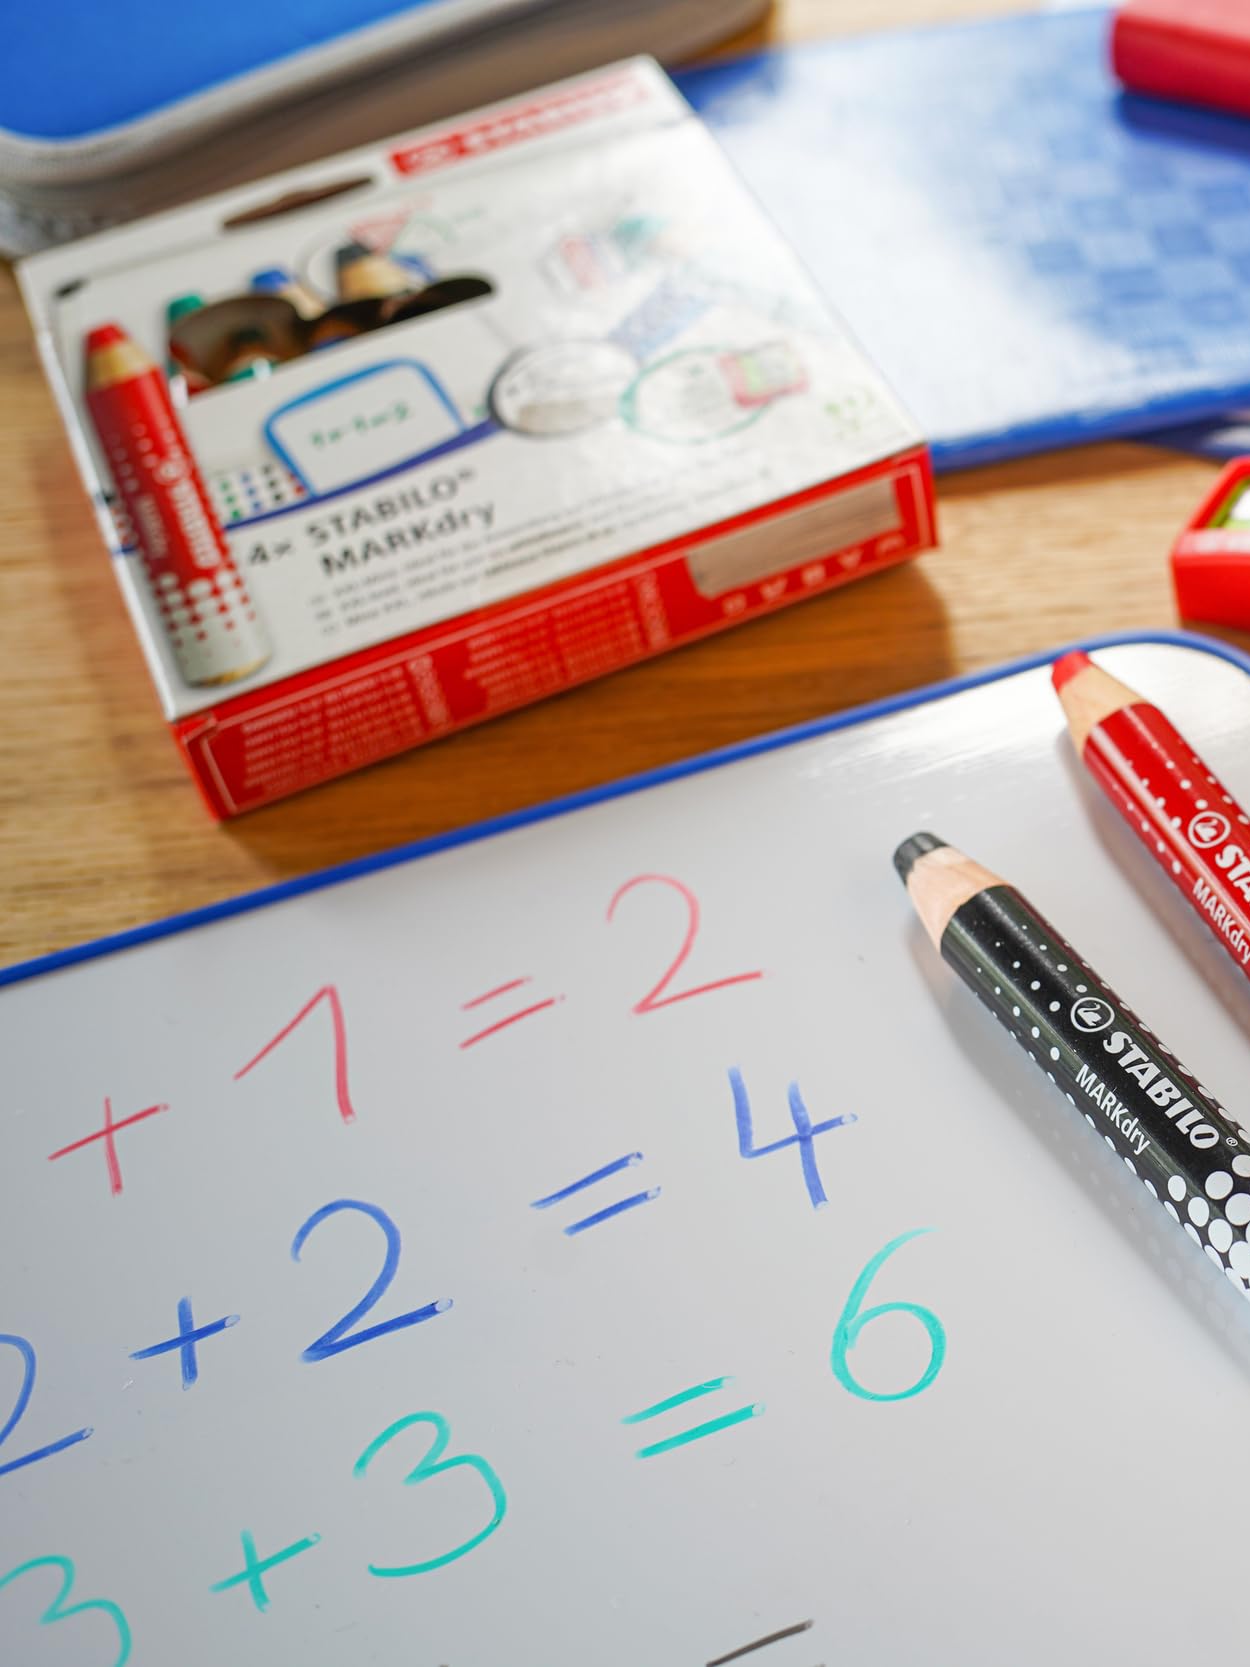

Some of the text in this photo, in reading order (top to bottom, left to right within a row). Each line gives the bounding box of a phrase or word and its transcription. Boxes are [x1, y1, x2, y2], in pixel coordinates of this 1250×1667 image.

[319, 502, 496, 576] MARKdry
[233, 985, 357, 1124] 1
[606, 874, 765, 1018] 2
[1075, 1063, 1152, 1156] MARKdry
[290, 1198, 453, 1363] 2
[727, 1066, 859, 1209] 4
[352, 1410, 508, 1579] 3
[829, 1227, 947, 1403] 6
